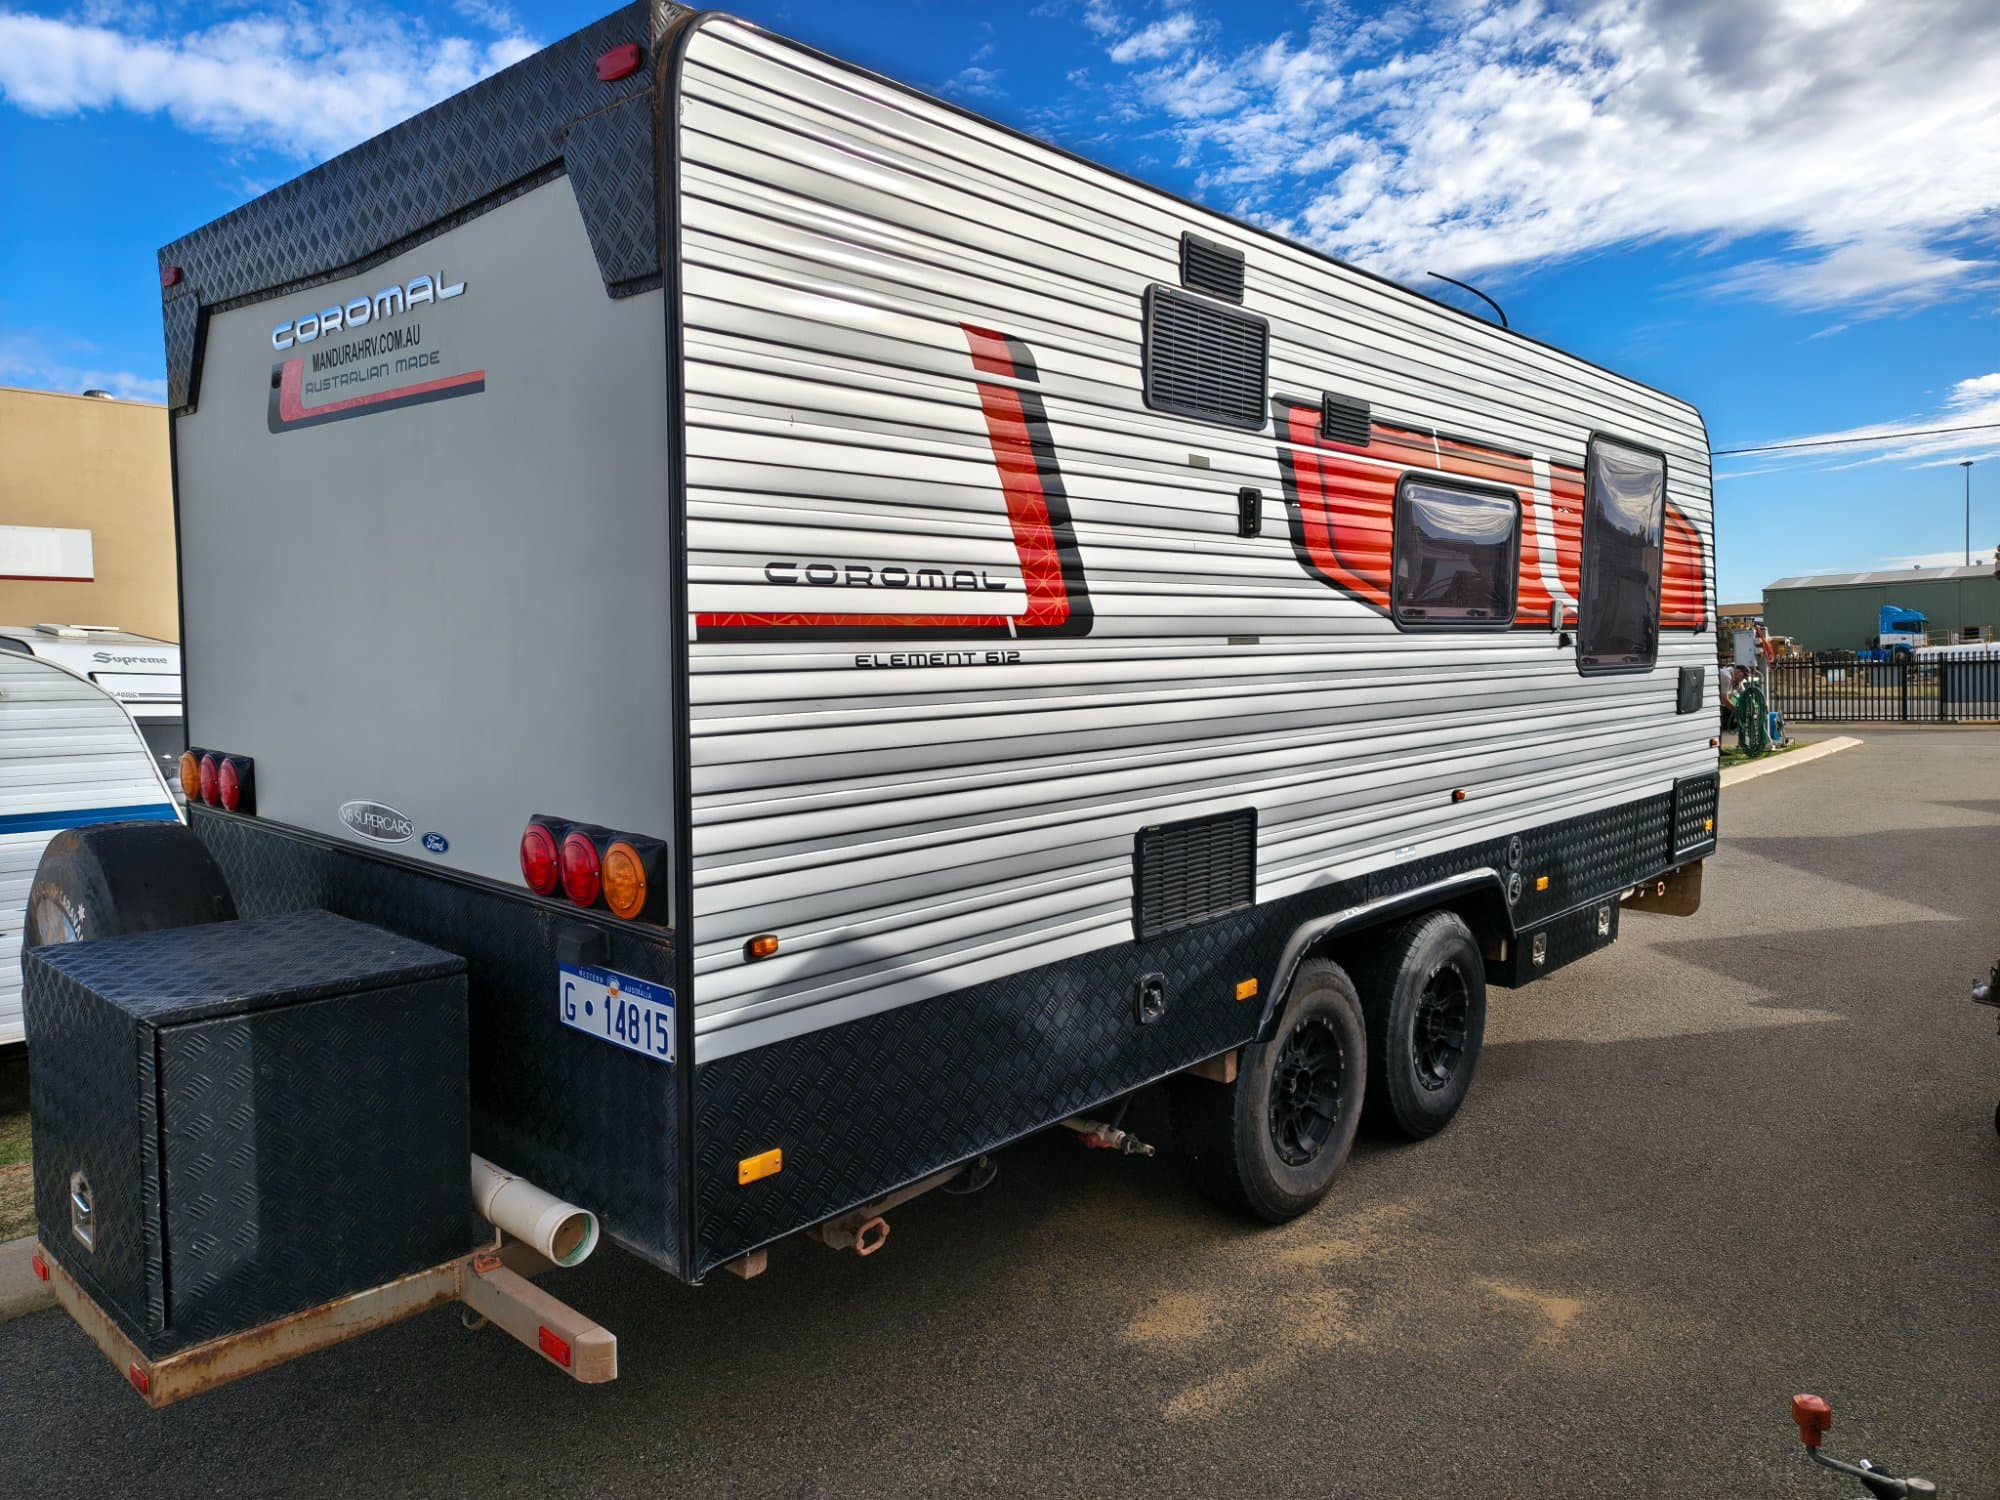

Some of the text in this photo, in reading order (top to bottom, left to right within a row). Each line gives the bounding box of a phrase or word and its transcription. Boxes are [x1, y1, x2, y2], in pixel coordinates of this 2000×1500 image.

[272, 270, 467, 350] COROMAL
[312, 324, 421, 372] MANDURAHRV.COM.AU
[305, 351, 440, 394] AUSTRALIAN MADE
[764, 562, 1007, 590] COROMAL
[92, 652, 168, 666] Supreme
[855, 651, 1021, 667] ELEMENT 612
[354, 810, 412, 836] SUPERCARS
[426, 835, 445, 851] Ford
